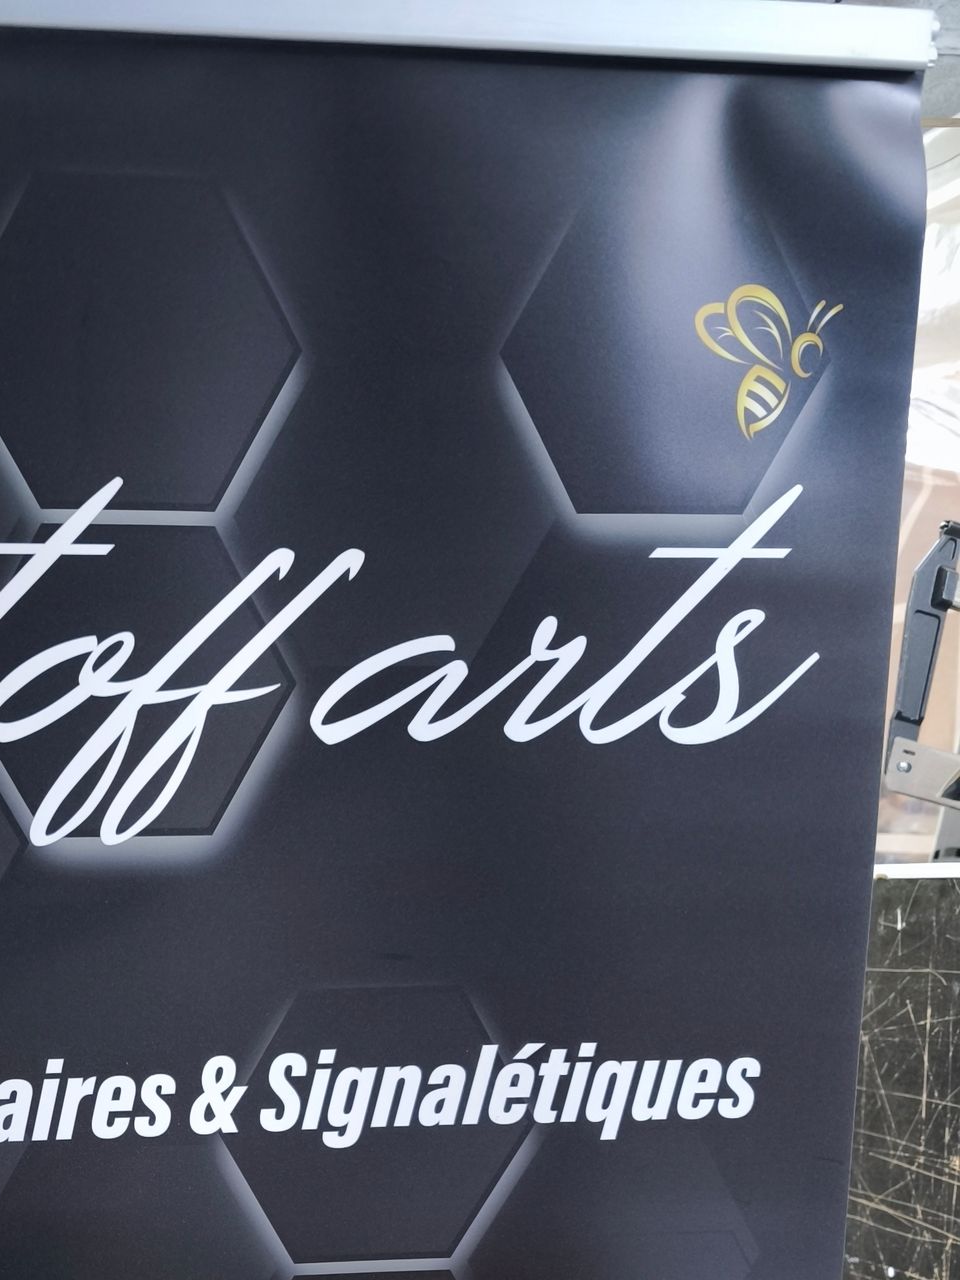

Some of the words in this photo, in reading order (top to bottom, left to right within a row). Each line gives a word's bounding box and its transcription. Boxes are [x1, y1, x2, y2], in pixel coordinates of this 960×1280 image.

[310, 484, 820, 745] arts
[190, 1055, 248, 1135] &
[260, 1041, 762, 1149] Signalétiques
